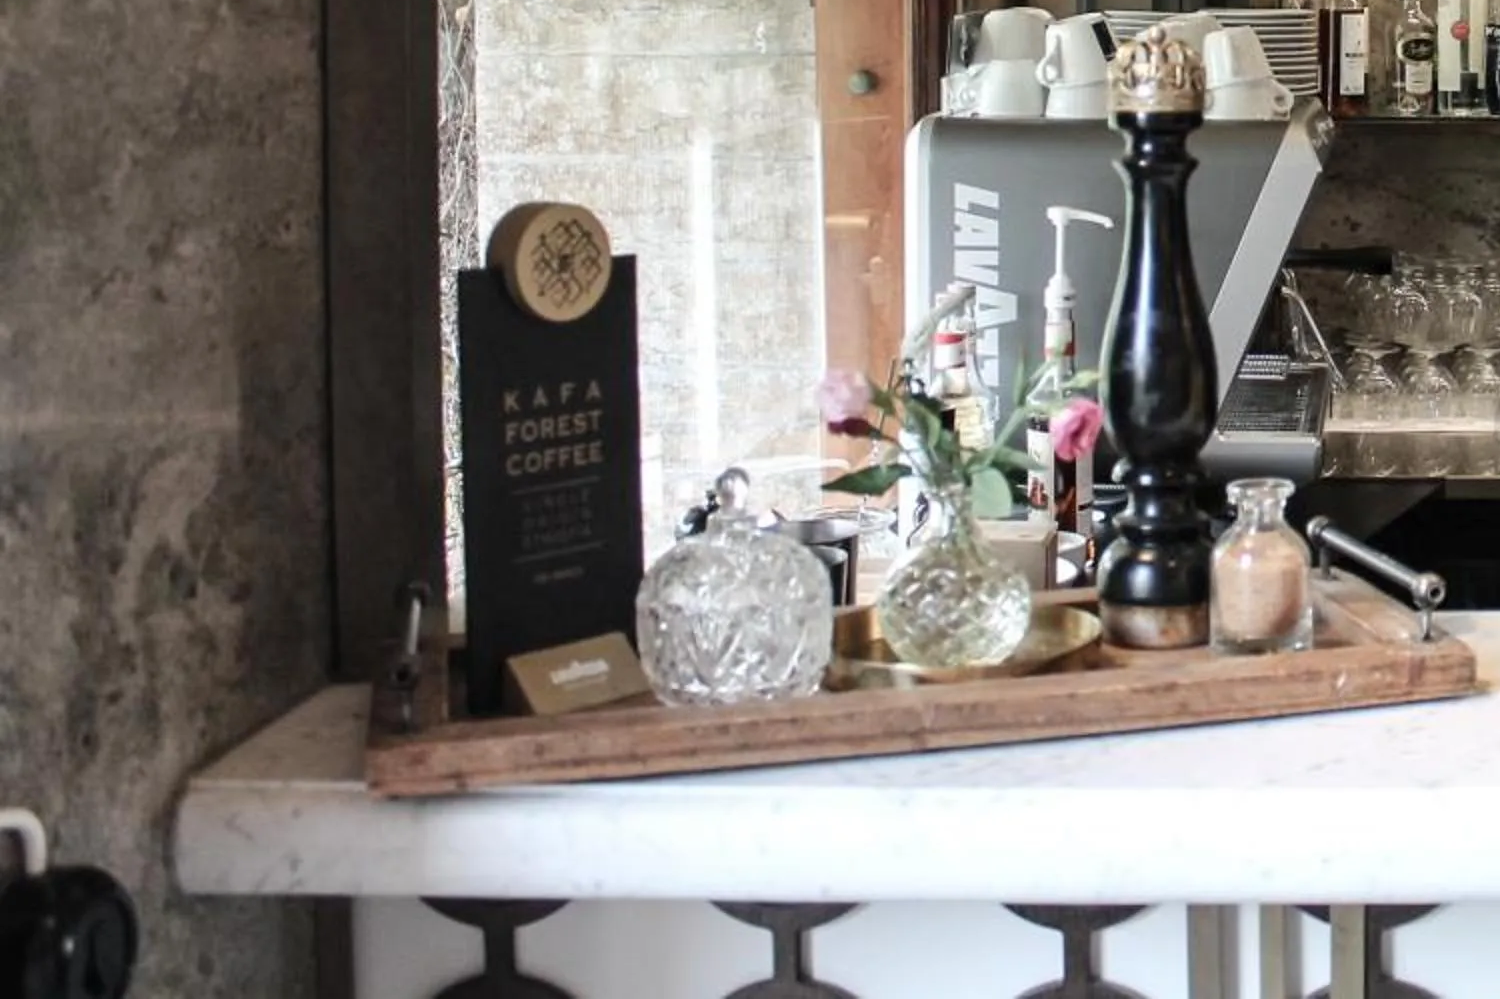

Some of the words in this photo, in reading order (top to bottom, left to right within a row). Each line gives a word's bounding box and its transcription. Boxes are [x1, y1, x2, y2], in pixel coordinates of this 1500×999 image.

[503, 379, 603, 414] KAFA
[505, 409, 604, 445] FOREST
[505, 439, 605, 476] COFFEE
